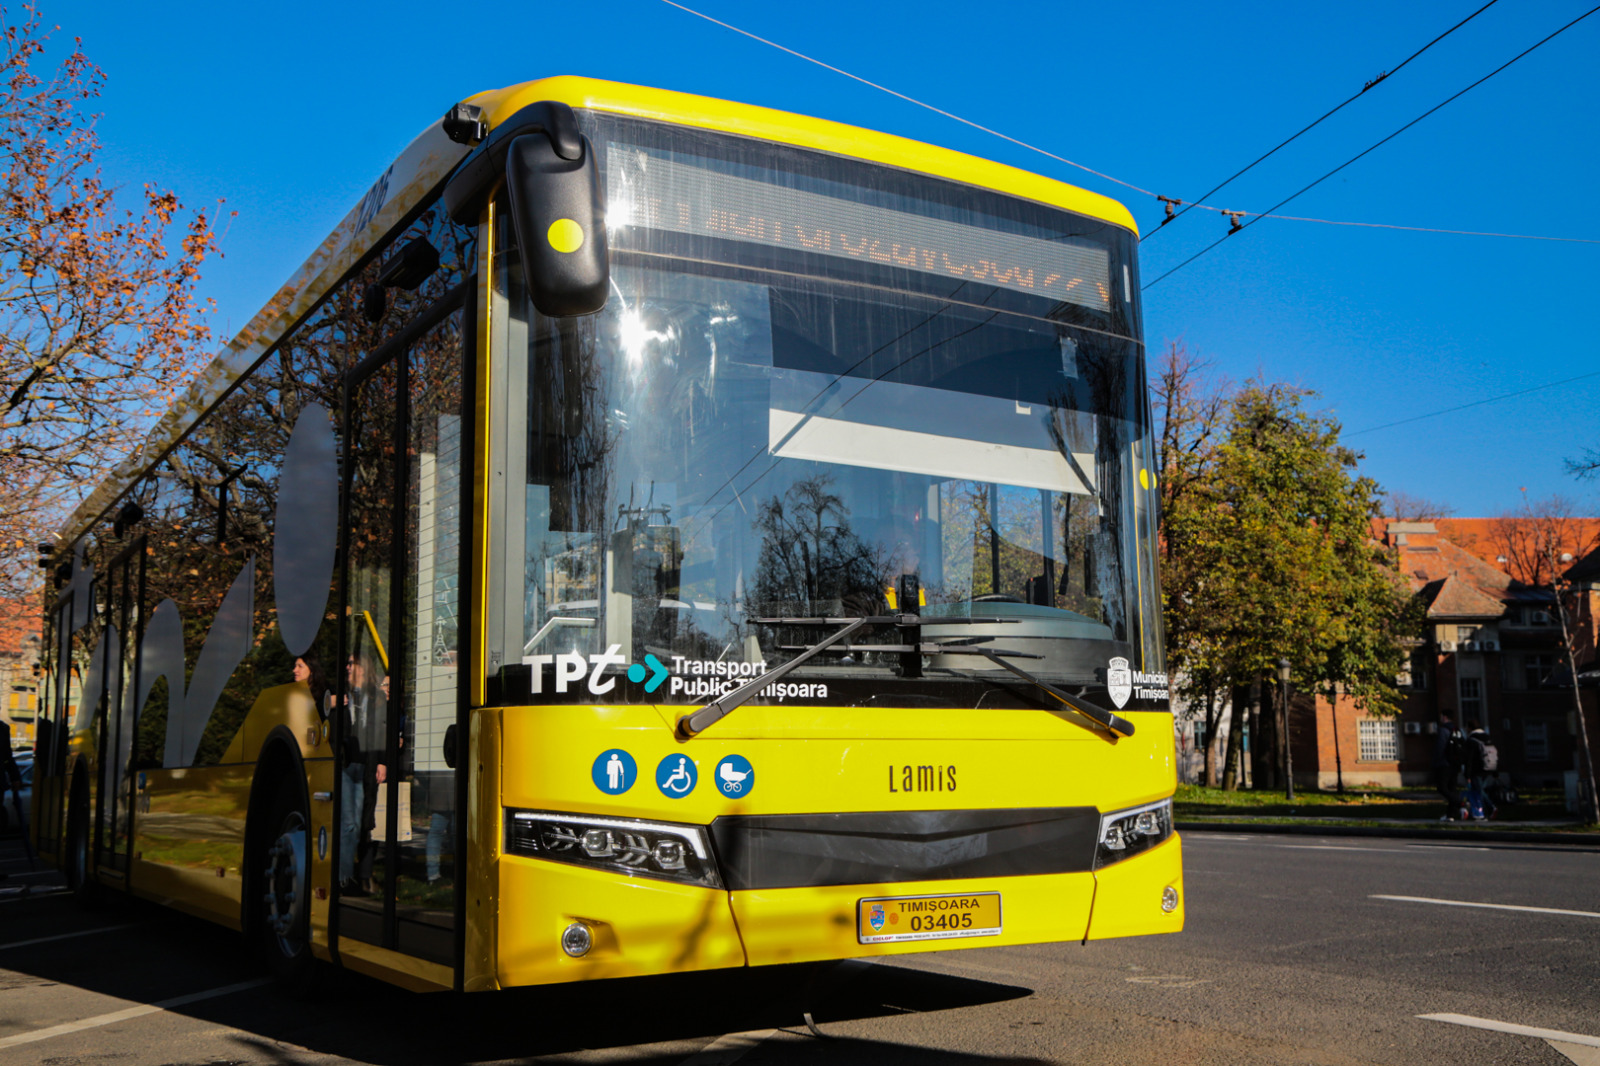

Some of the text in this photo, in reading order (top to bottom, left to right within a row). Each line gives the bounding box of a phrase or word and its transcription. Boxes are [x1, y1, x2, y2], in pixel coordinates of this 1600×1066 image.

[671, 656, 768, 680] Transport
[670, 677, 828, 702] Public Tișoara
[910, 913, 972, 931] 03405
